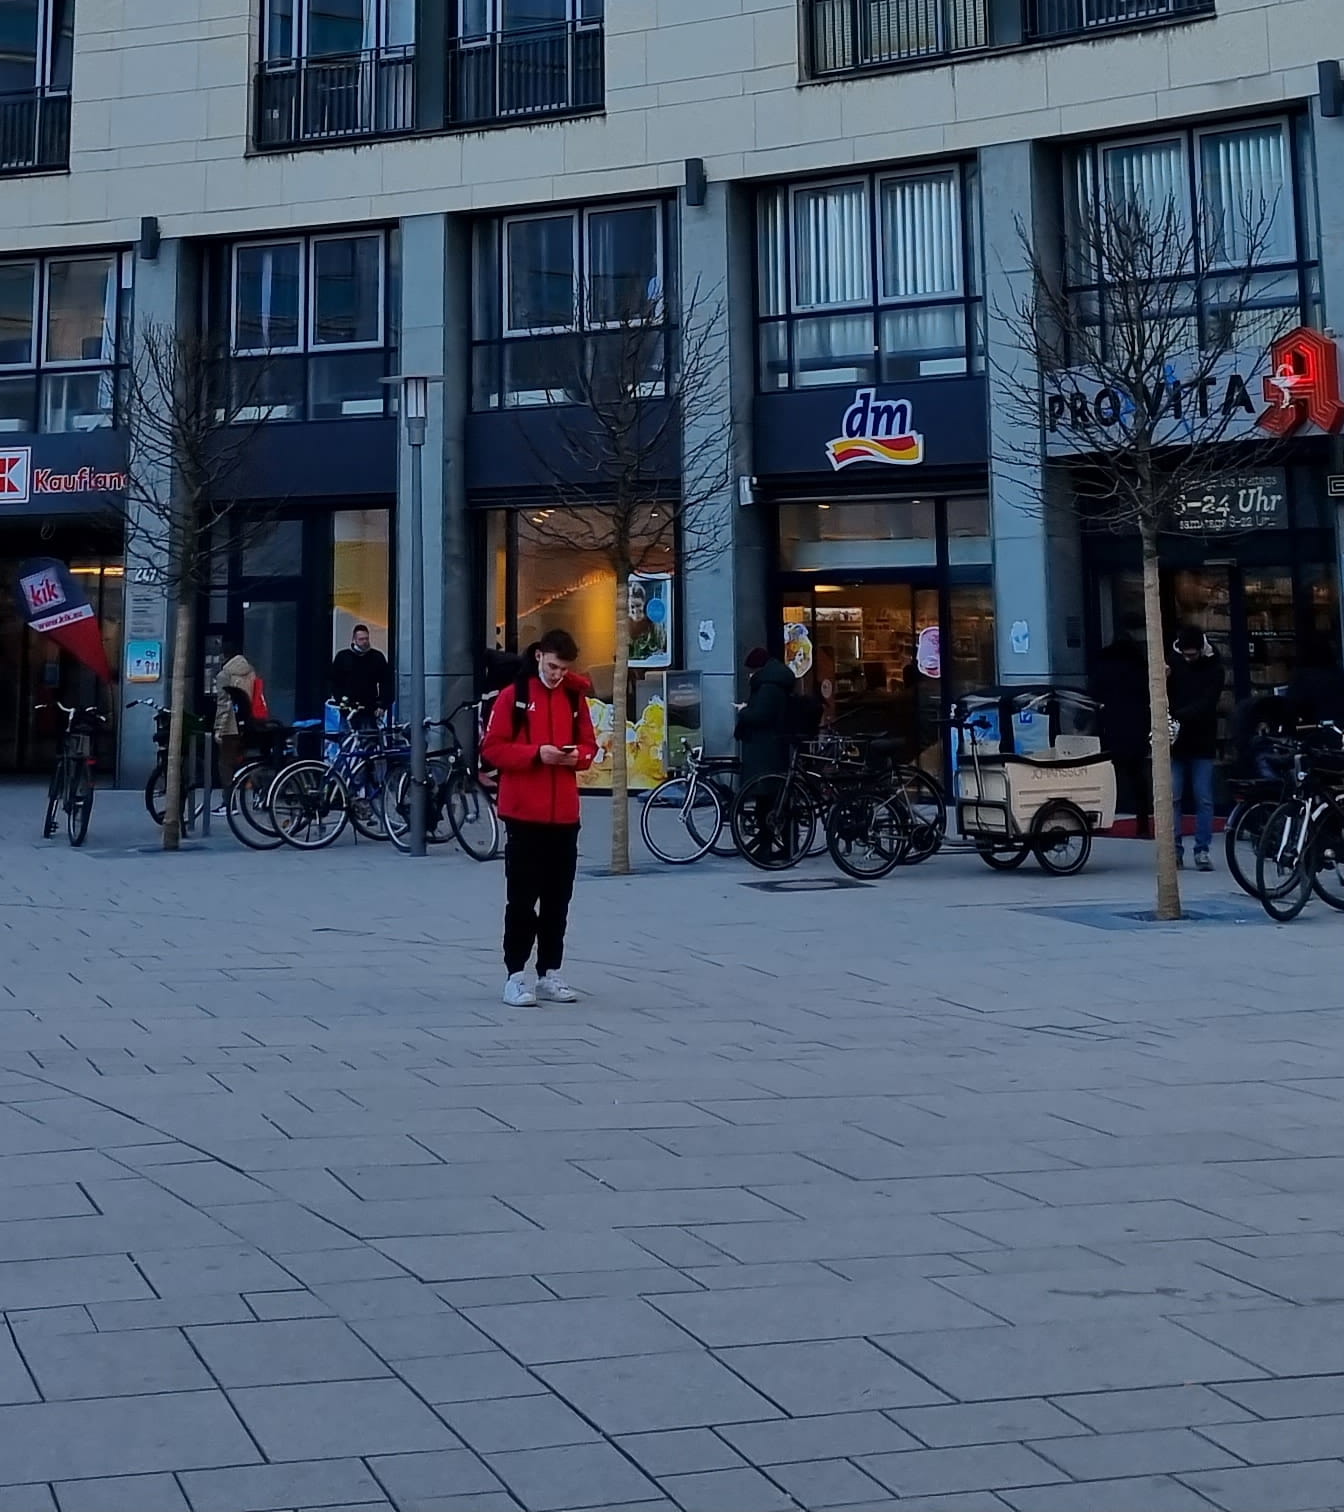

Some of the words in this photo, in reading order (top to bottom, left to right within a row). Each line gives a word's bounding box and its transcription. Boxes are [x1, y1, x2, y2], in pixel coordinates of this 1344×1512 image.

[845, 392, 908, 438] dm
[1238, 486, 1283, 513] Uhr
[30, 576, 59, 607] kik
